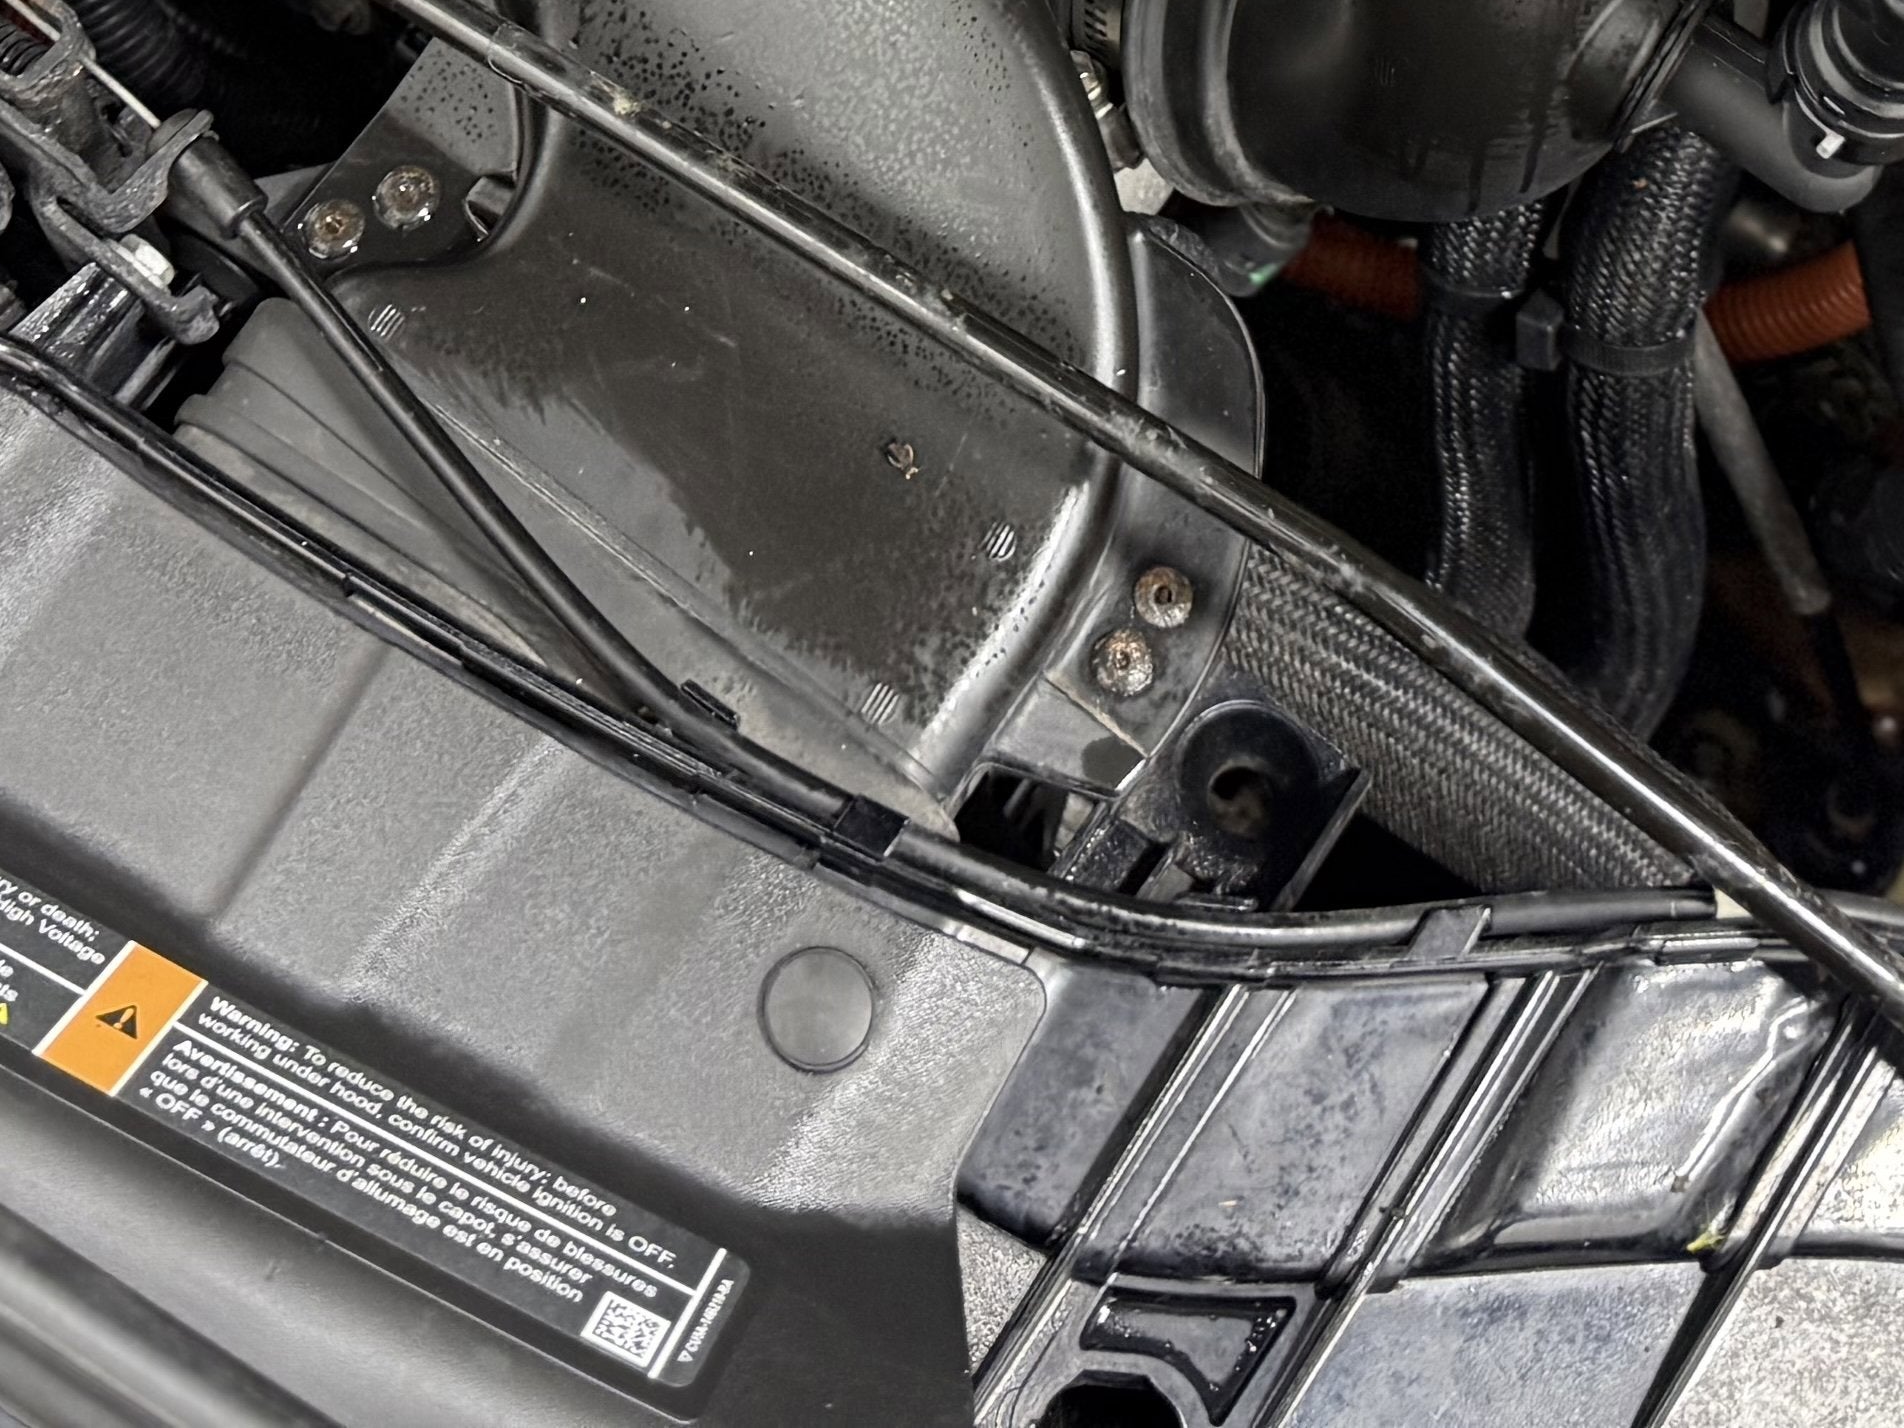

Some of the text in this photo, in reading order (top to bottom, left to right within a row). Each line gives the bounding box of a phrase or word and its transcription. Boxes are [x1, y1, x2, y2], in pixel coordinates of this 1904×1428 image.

[17, 891, 42, 907] or
[38, 918, 106, 965] Voltage
[150, 1070, 584, 1303] que le commutateur d'allumage est en position
[154, 1092, 203, 1121] OFF
[216, 1126, 286, 1169] (arrêt).
[161, 1052, 594, 1284] lors d'une intervention sous le capot, s'assurer
[172, 1039, 319, 1123] Avertissement
[329, 1120, 381, 1153] Pour
[378, 1148, 448, 1190] réduire
[448, 1181, 470, 1201] le
[470, 1195, 532, 1233] risque
[533, 1228, 562, 1249] de
[562, 1240, 658, 1298] blessures
[198, 1012, 273, 1060] working
[272, 1048, 331, 1088] under
[329, 1080, 383, 1119] hood,
[387, 1114, 460, 1157] confirm
[463, 1151, 533, 1193] vehicle
[531, 1185, 604, 1231] ignition
[628, 1235, 677, 1269] OFF.
[209, 996, 300, 1053] Warning:
[303, 1044, 327, 1066] To
[326, 1061, 395, 1102] reduce
[396, 1095, 429, 1120] the
[429, 1114, 468, 1140] risk
[467, 1135, 495, 1152] of
[552, 1175, 617, 1217] before
